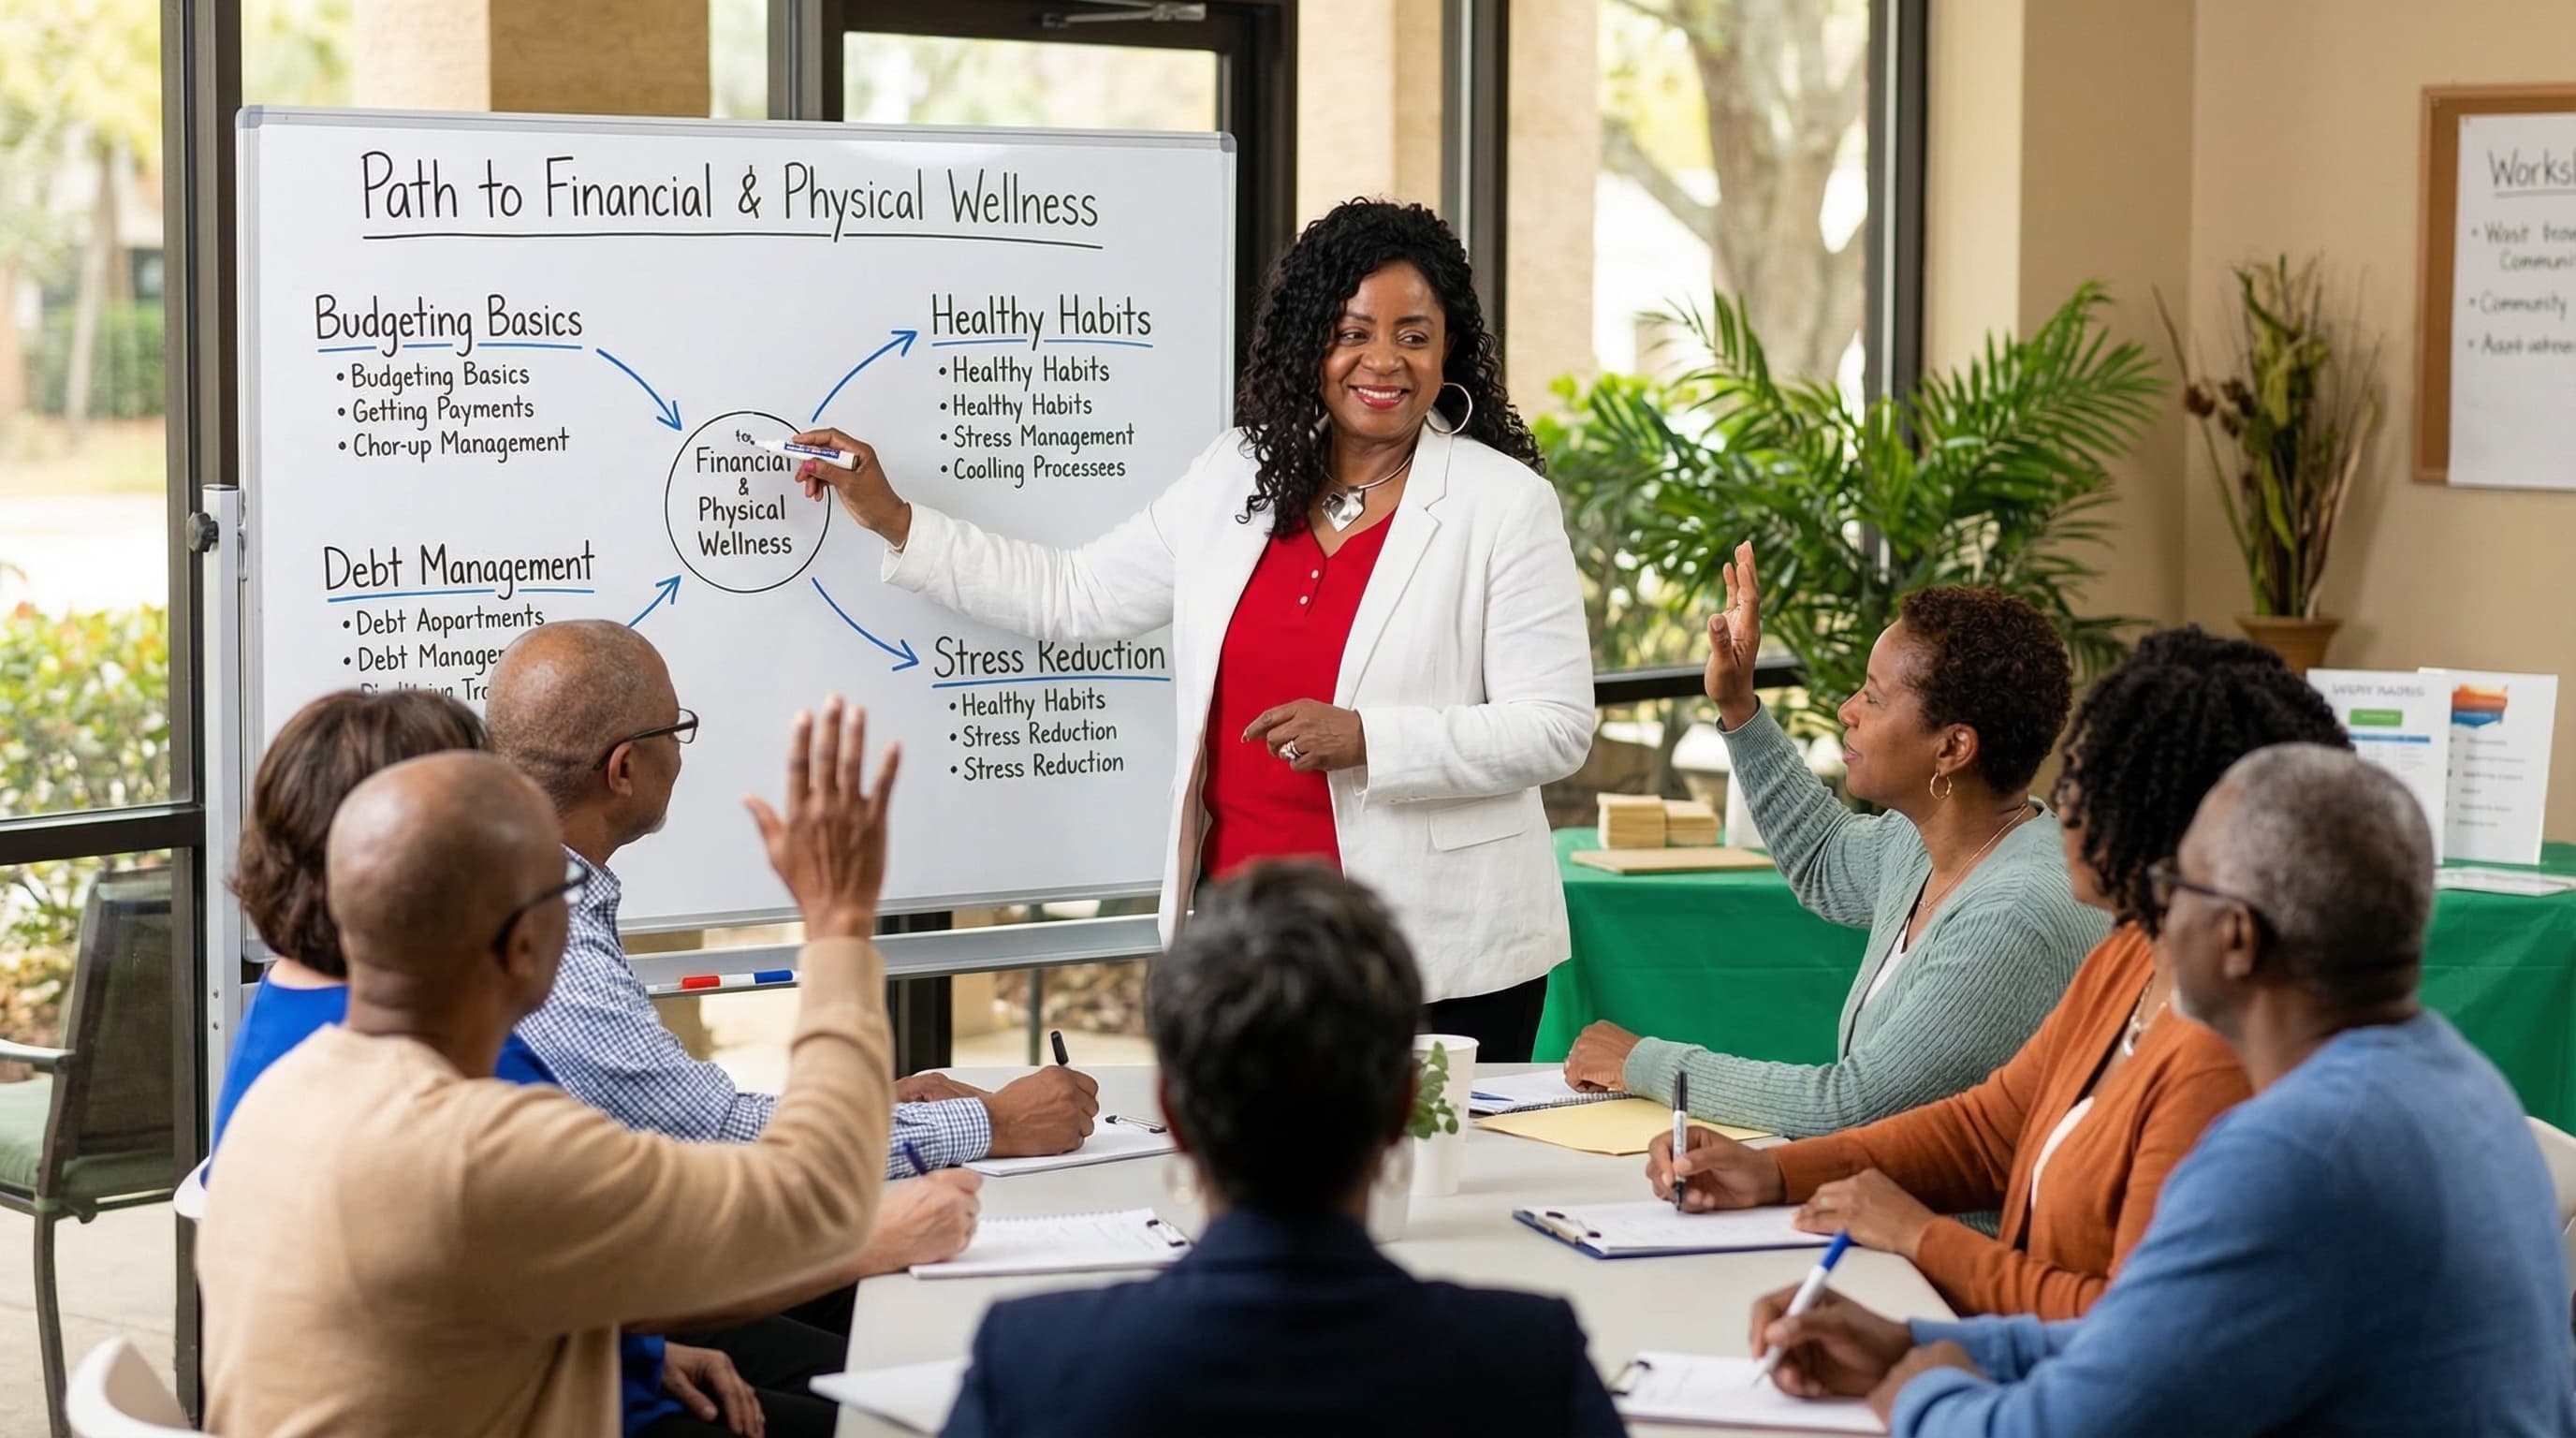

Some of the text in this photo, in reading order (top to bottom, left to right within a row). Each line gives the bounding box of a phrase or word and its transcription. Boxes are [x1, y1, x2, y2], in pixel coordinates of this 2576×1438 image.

[360, 151, 1098, 243] Path to Financial & Physical Wellness
[315, 294, 582, 358] Budgeting Basics
[932, 293, 1151, 352] Healthy Habits
[351, 360, 530, 396] Budgeting Basics
[953, 355, 1110, 392] Healthy Habits
[353, 393, 534, 433] Getting Payments
[953, 392, 1092, 424] Healthy Habits
[354, 426, 570, 463] Chor-up Management
[954, 422, 1134, 455] Stress Management
[738, 477, 749, 496] &
[954, 455, 1126, 489] Coolling Processees
[699, 492, 785, 530] Physical
[697, 530, 793, 557] Wellness
[324, 539, 595, 601] Debt Management
[357, 609, 407, 636] Debt
[359, 643, 505, 676] Debt Manage
[933, 636, 1024, 679] Stress
[962, 686, 1106, 721] Healthy Habits
[962, 718, 1118, 748] Stress Reduction
[963, 750, 1124, 782] Stress Reduction
